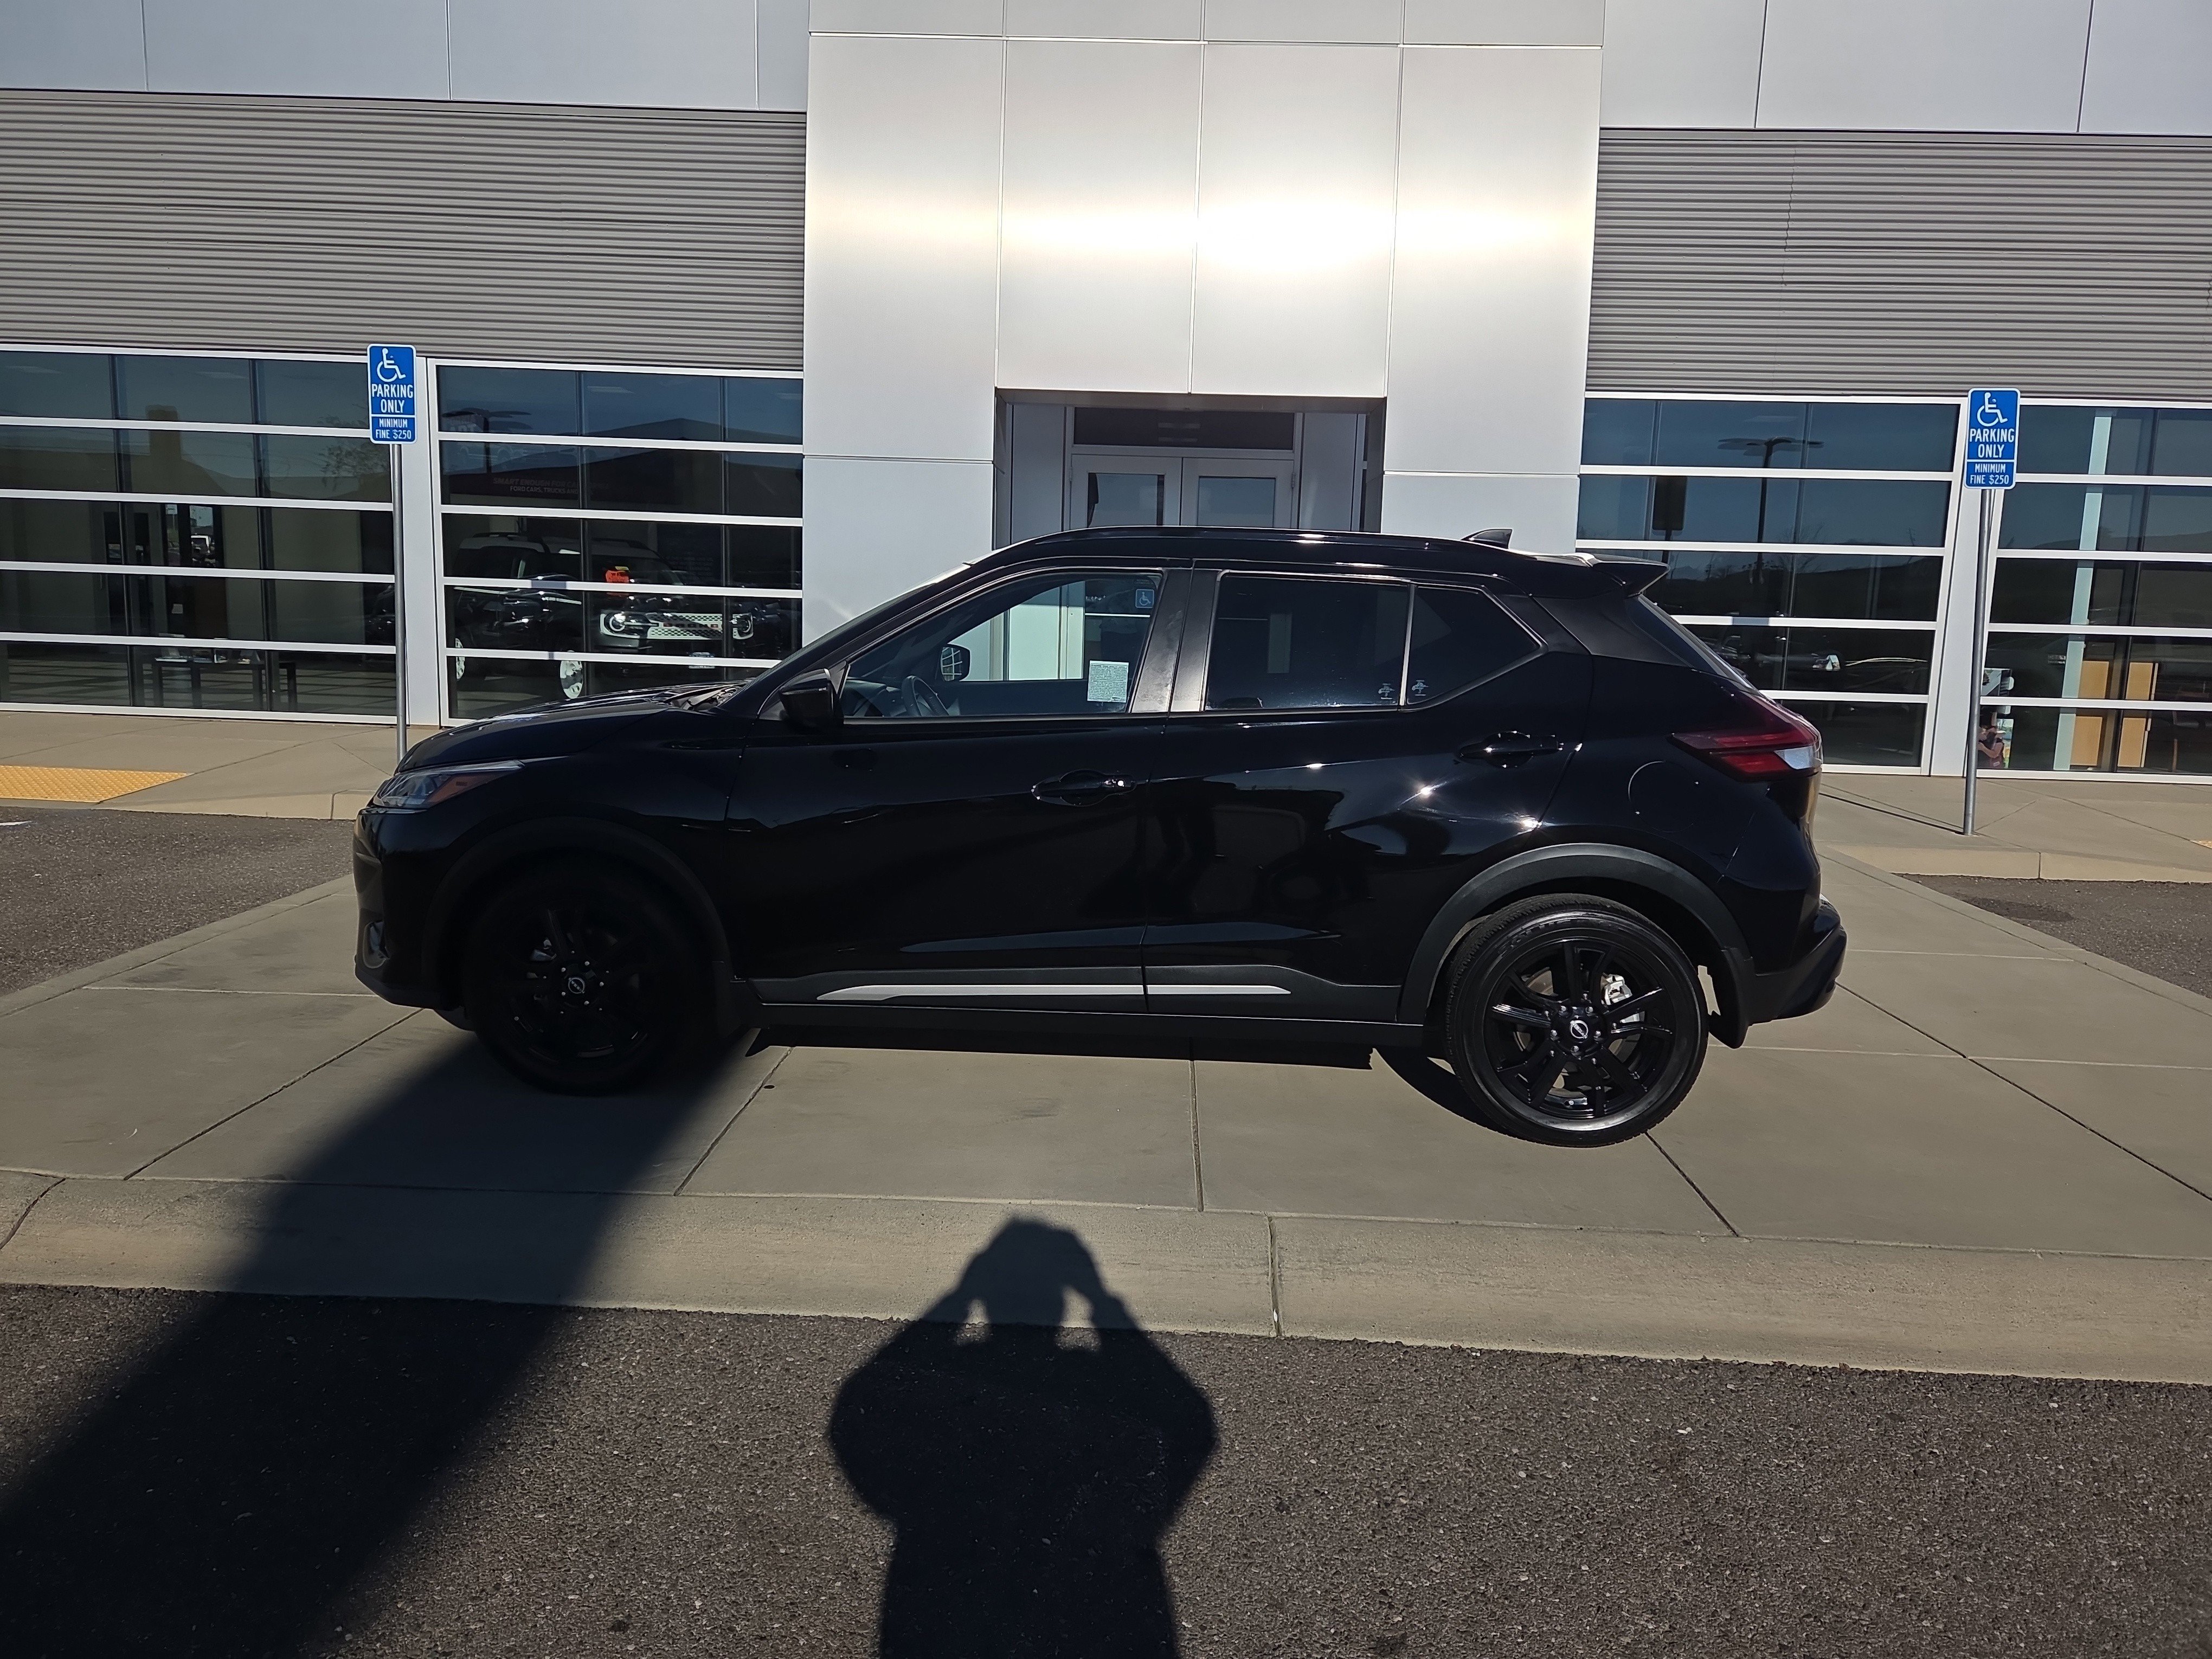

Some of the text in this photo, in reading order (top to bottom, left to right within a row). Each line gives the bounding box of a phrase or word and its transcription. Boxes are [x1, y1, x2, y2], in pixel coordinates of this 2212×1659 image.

[371, 383, 414, 398] PARKING
[380, 399, 405, 413] ONLY
[378, 418, 408, 428] MINIMUM
[375, 429, 411, 440] FINE $250
[1969, 428, 2015, 443] PARKING
[1978, 443, 2005, 458] ONLY
[1975, 463, 2006, 473] MINIMUM
[1970, 474, 2009, 485] FINE $250
